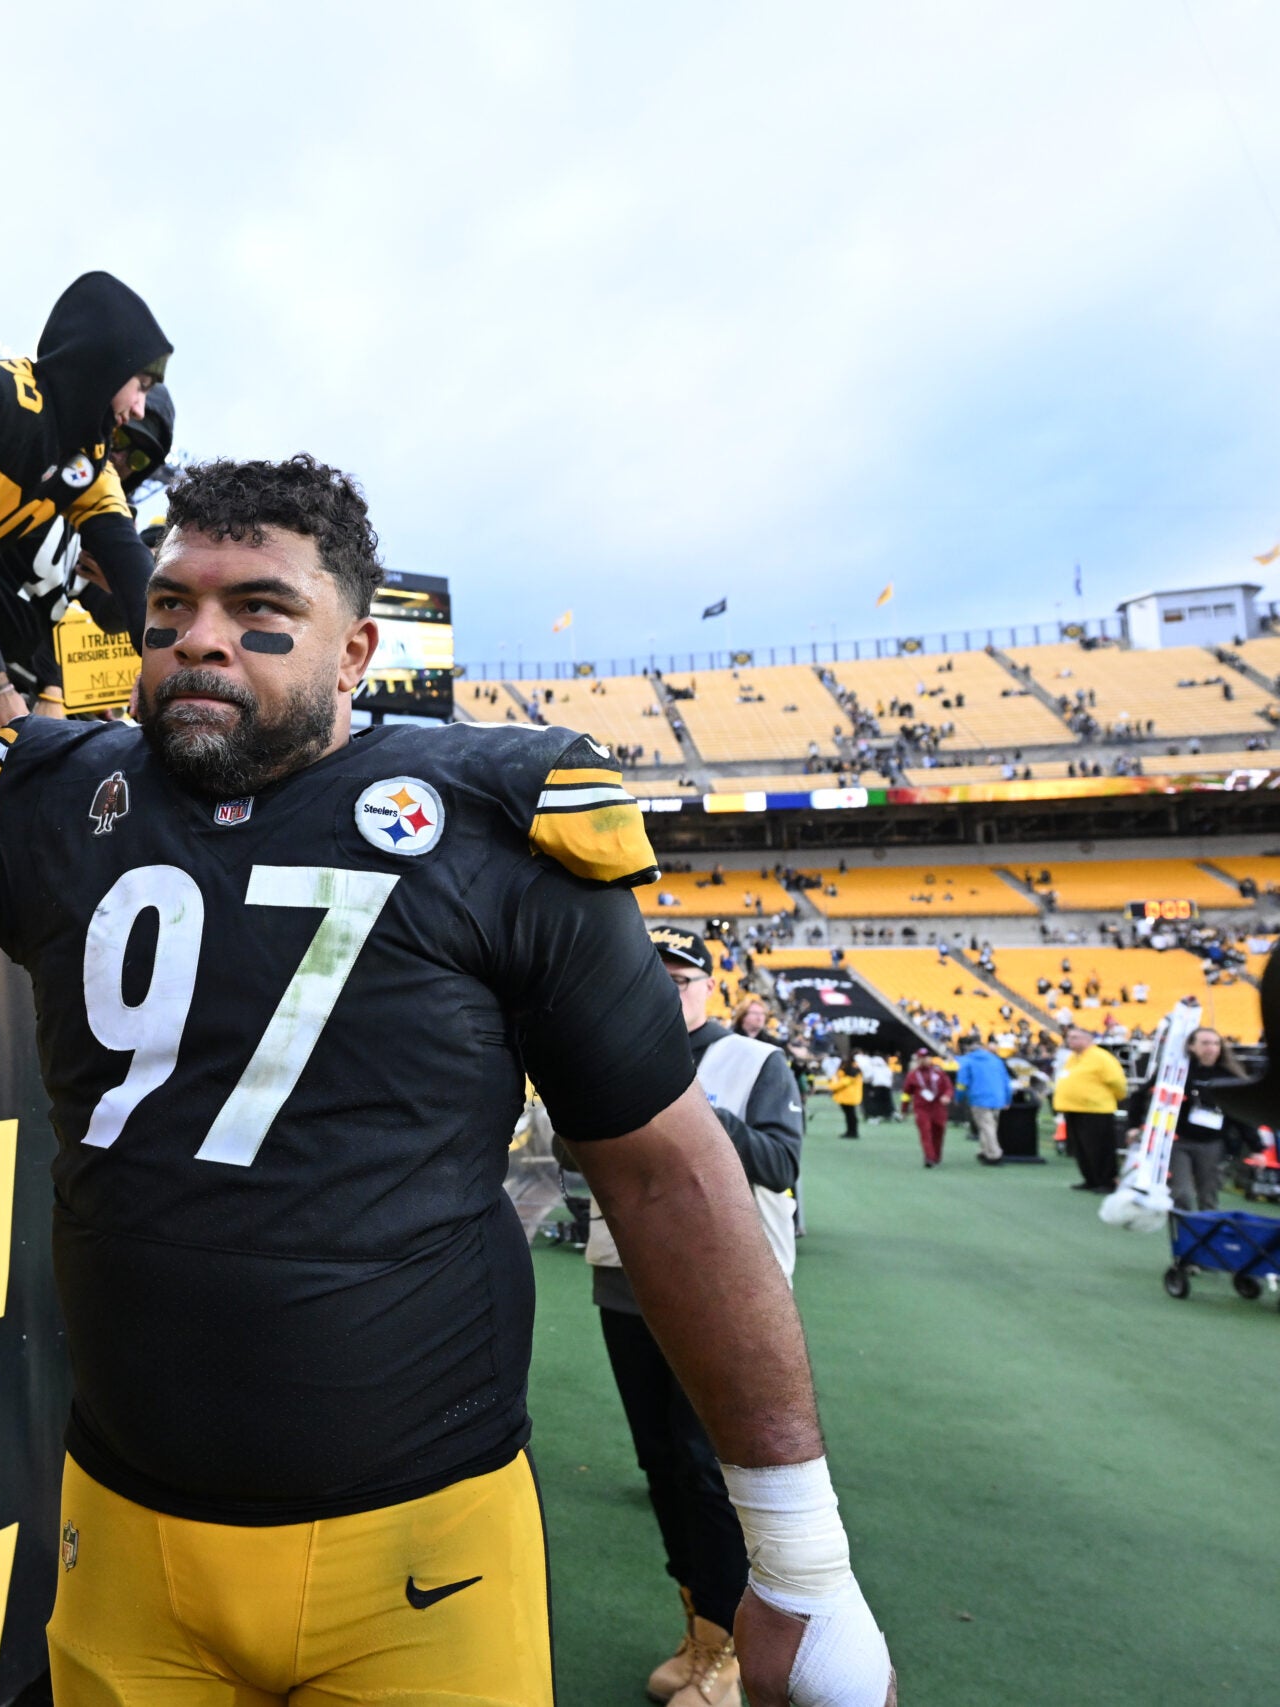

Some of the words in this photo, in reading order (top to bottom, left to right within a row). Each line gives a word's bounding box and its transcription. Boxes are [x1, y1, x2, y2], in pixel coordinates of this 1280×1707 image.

[67, 648, 110, 664] ACRISURE
[219, 805, 244, 821] NFL
[363, 803, 398, 818] Steelers
[80, 863, 401, 1167] 97
